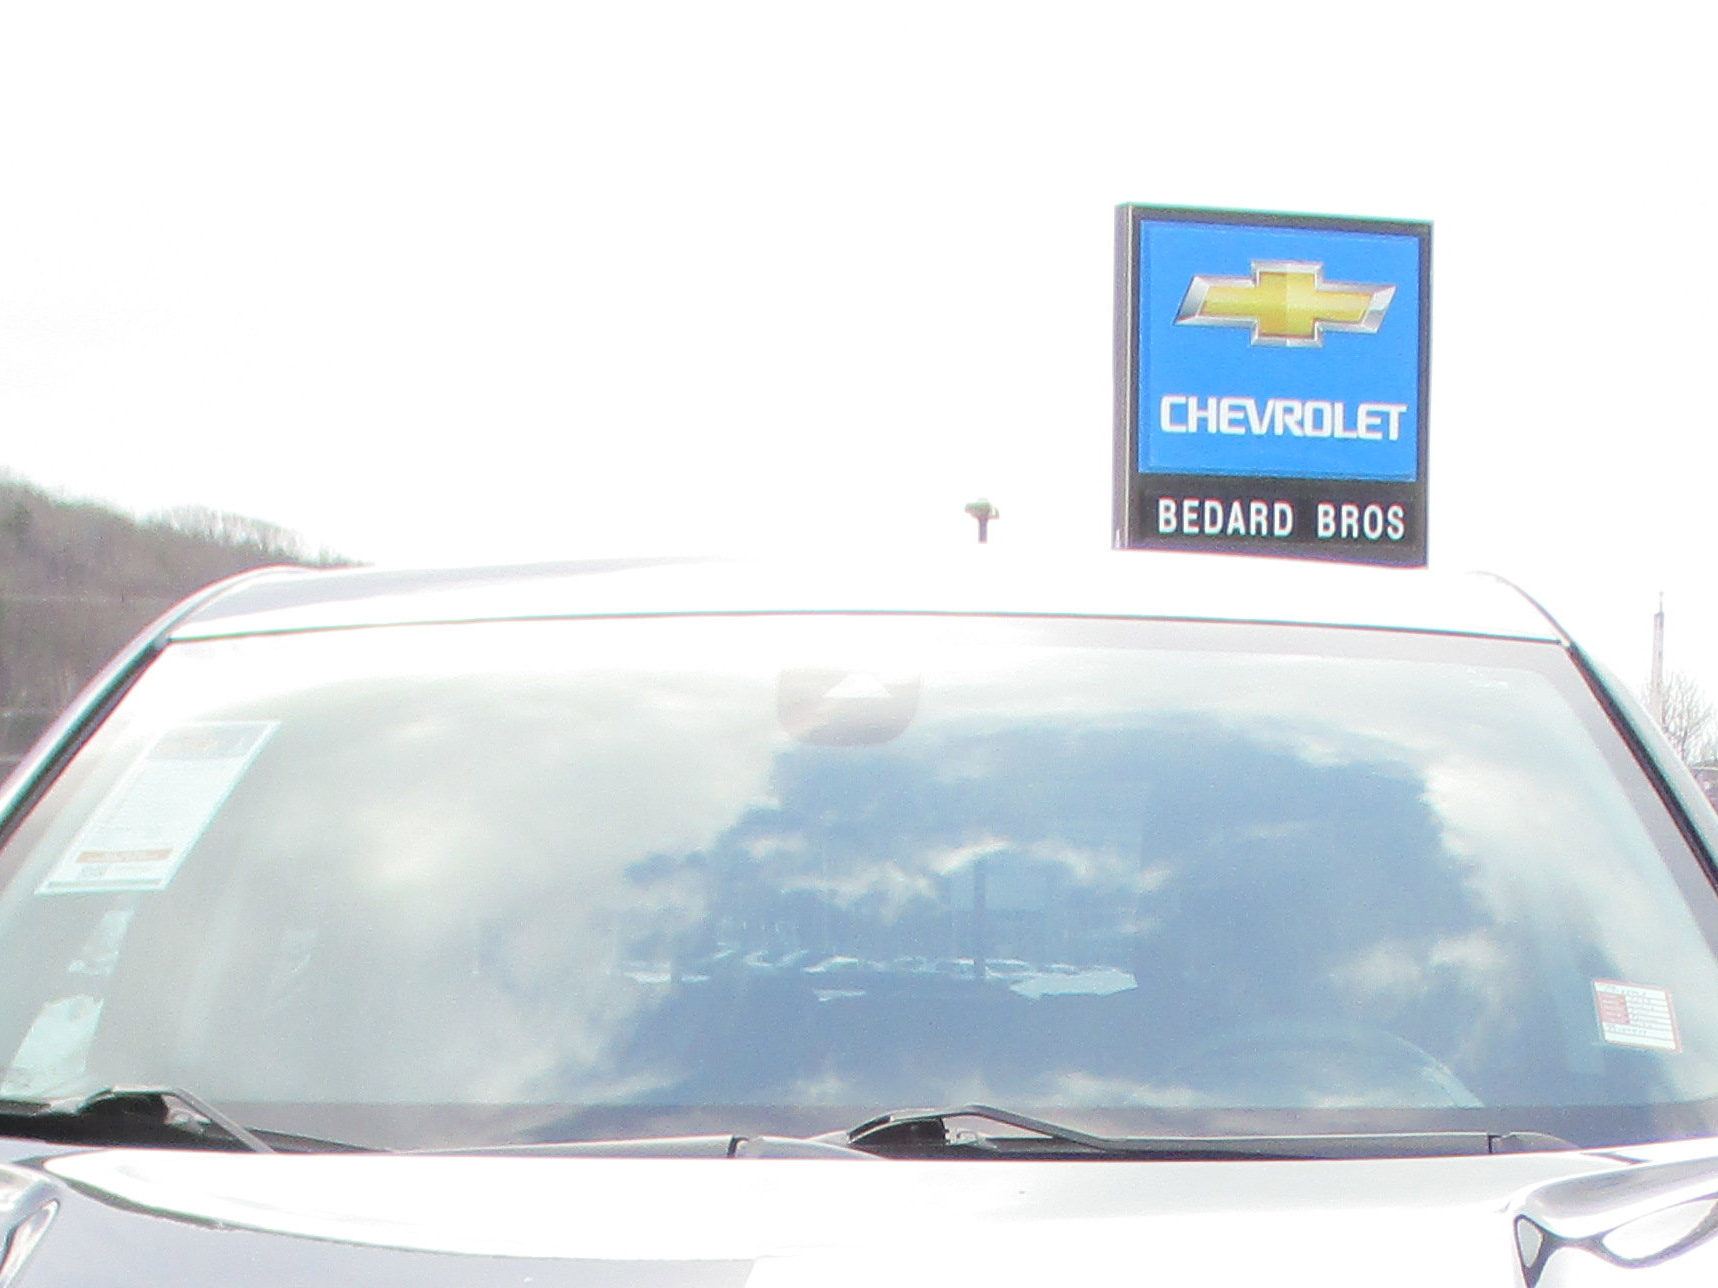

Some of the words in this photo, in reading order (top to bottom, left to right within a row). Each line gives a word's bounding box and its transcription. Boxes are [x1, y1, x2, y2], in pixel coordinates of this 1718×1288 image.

[1160, 394, 1409, 441] CHEVROLET
[1157, 497, 1294, 537] BEDARD
[1316, 502, 1406, 541] BROS
